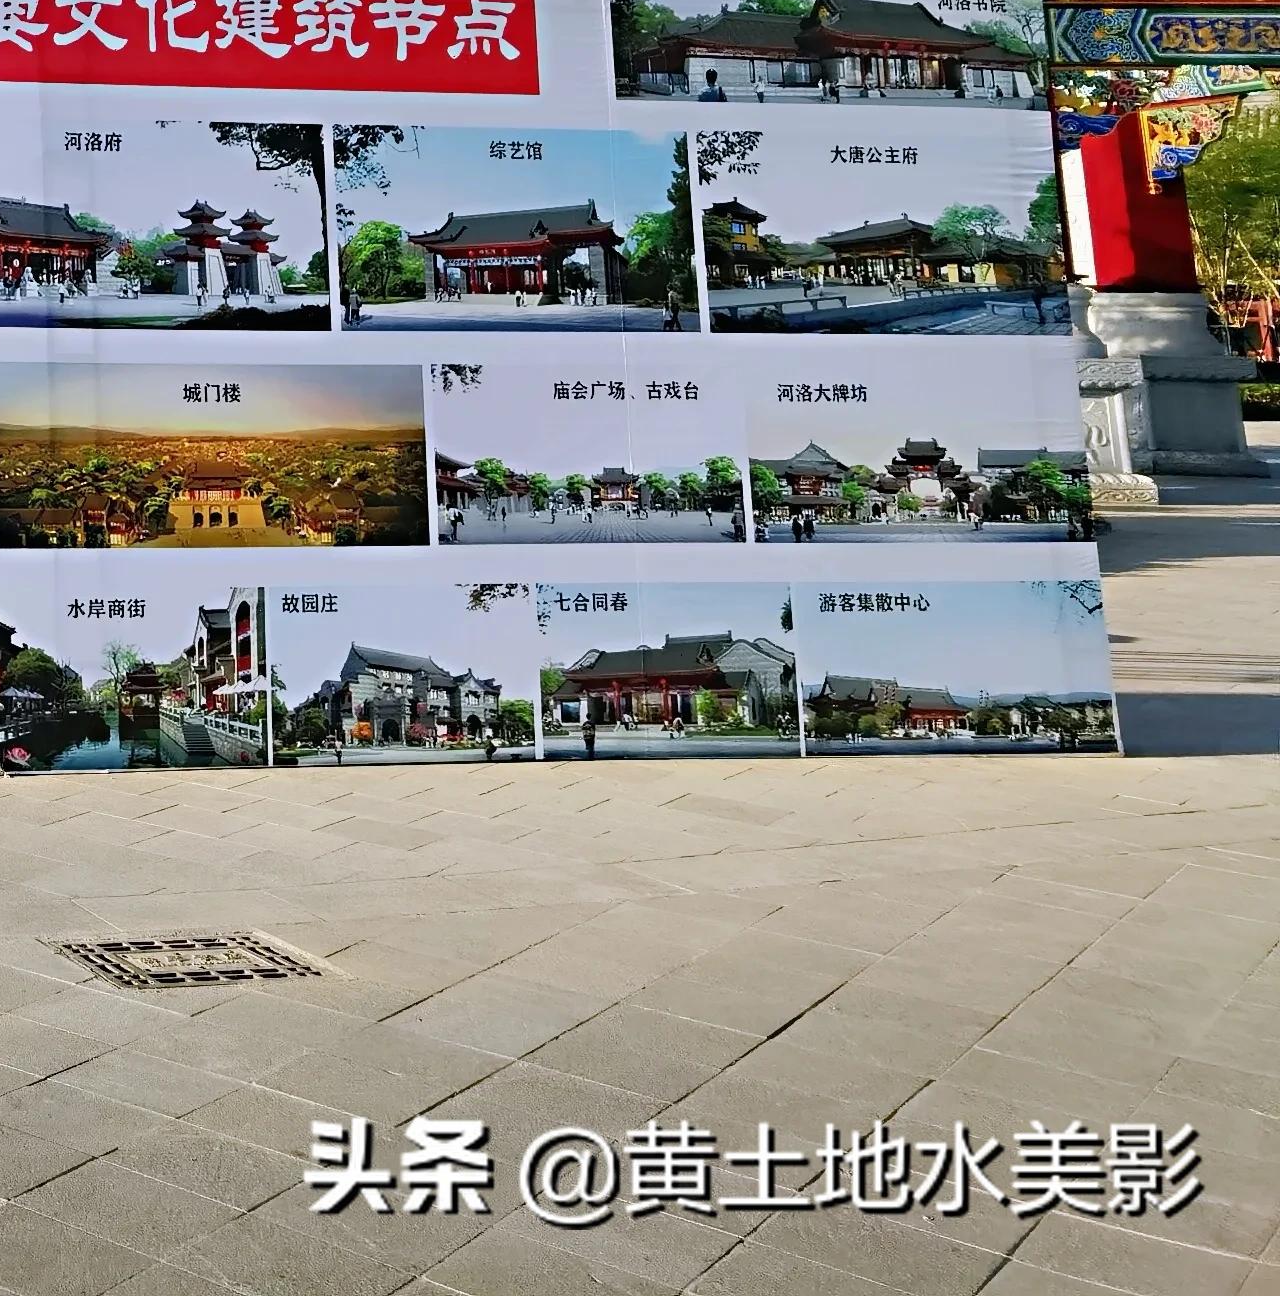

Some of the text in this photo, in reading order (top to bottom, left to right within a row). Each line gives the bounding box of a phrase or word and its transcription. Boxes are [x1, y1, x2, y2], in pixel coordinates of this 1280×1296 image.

[64, 132, 123, 153] 河洛府
[489, 141, 543, 161] 综艺馆
[830, 146, 919, 166] 大唐公主府
[182, 382, 241, 403] 城门楼
[552, 380, 699, 401] 庙会广场、古戏台
[777, 383, 868, 403] 河洛大牌坊
[67, 598, 146, 619] 水岸商街
[281, 593, 338, 614] 故园庄
[554, 592, 629, 613] 七合同春
[819, 593, 930, 612] 游客集散中心
